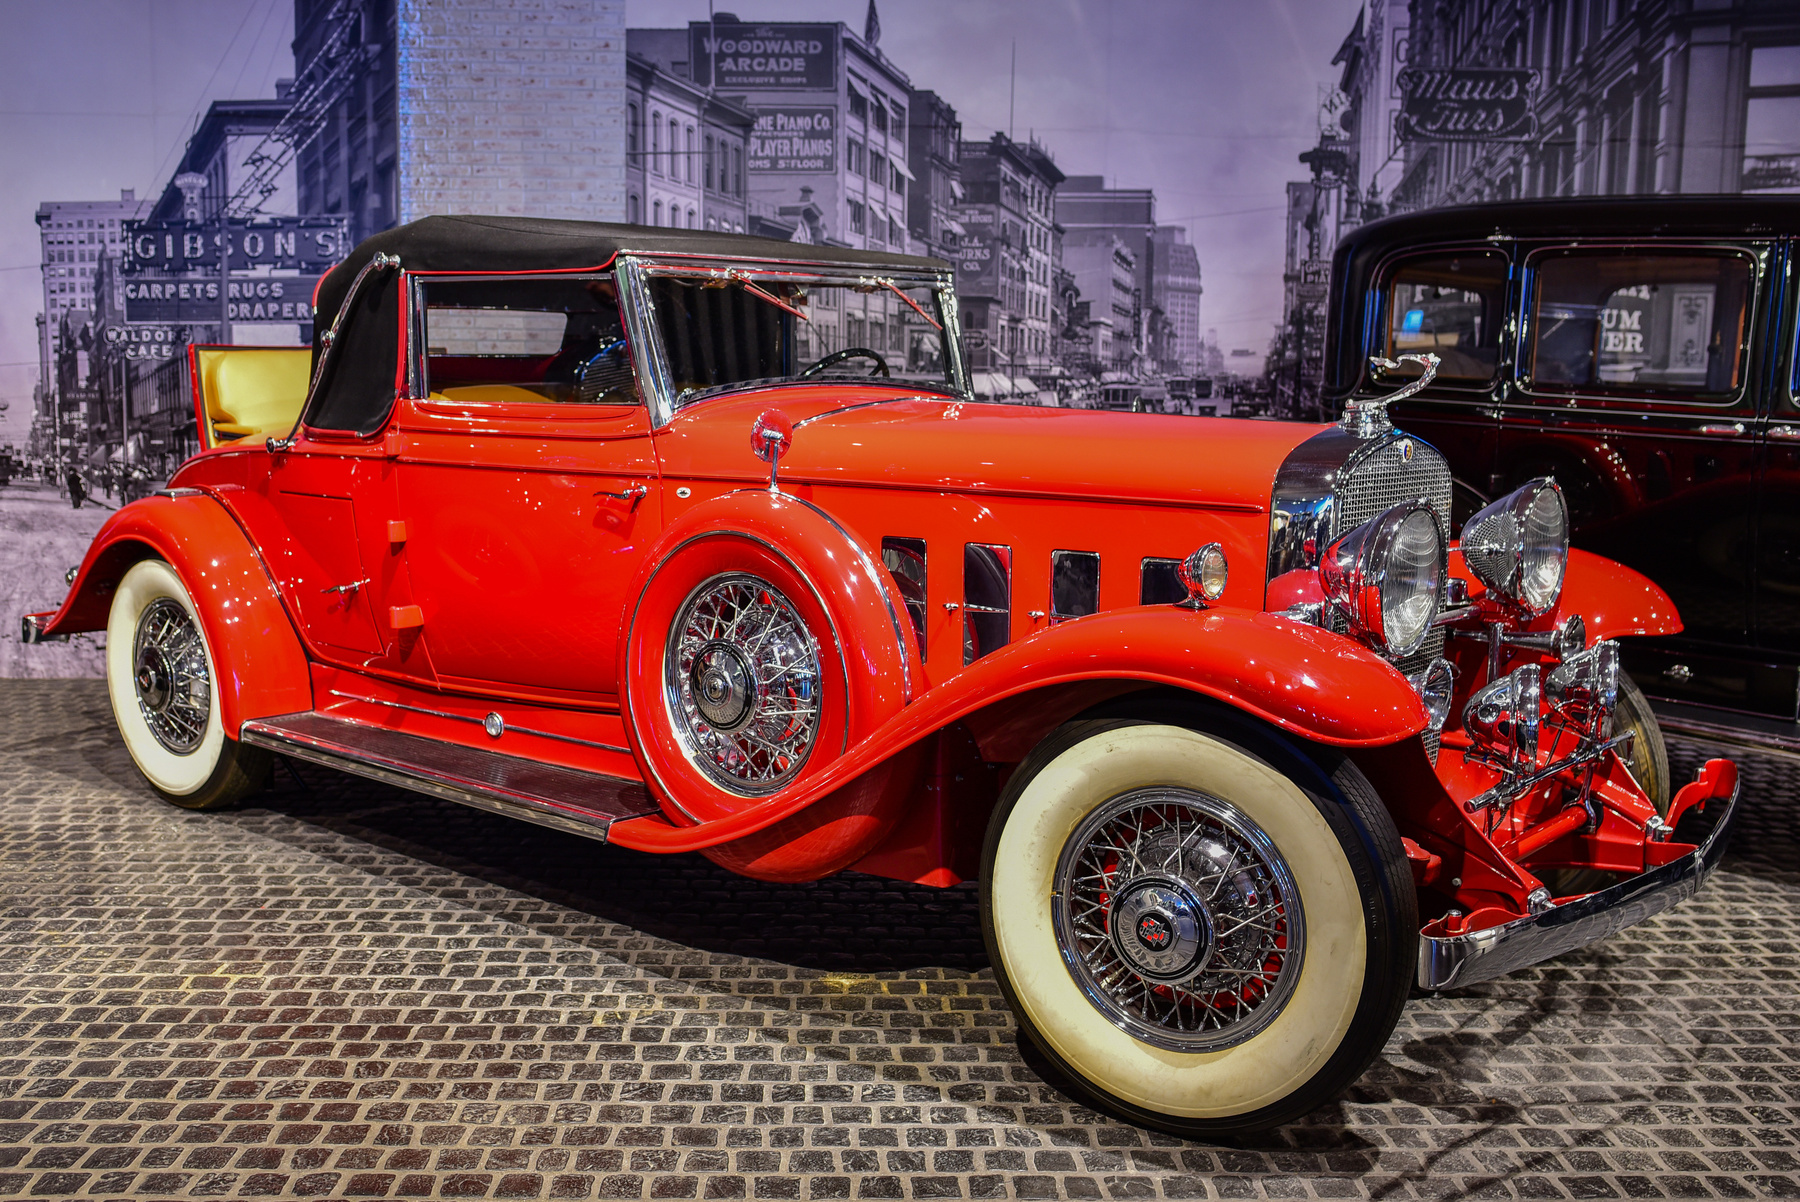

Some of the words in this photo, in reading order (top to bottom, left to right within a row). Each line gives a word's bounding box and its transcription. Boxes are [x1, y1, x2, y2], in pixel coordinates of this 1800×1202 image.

[703, 38, 823, 54] WOODWARD
[719, 57, 806, 72] ARCADE
[776, 113, 812, 131] PIANO
[791, 137, 833, 157] PIANOS
[135, 231, 336, 259] GIBSON'S
[125, 283, 219, 300] CARPETS
[228, 282, 284, 299] RUGS
[228, 302, 313, 320] DRAPER
[127, 344, 173, 357] CAFE
